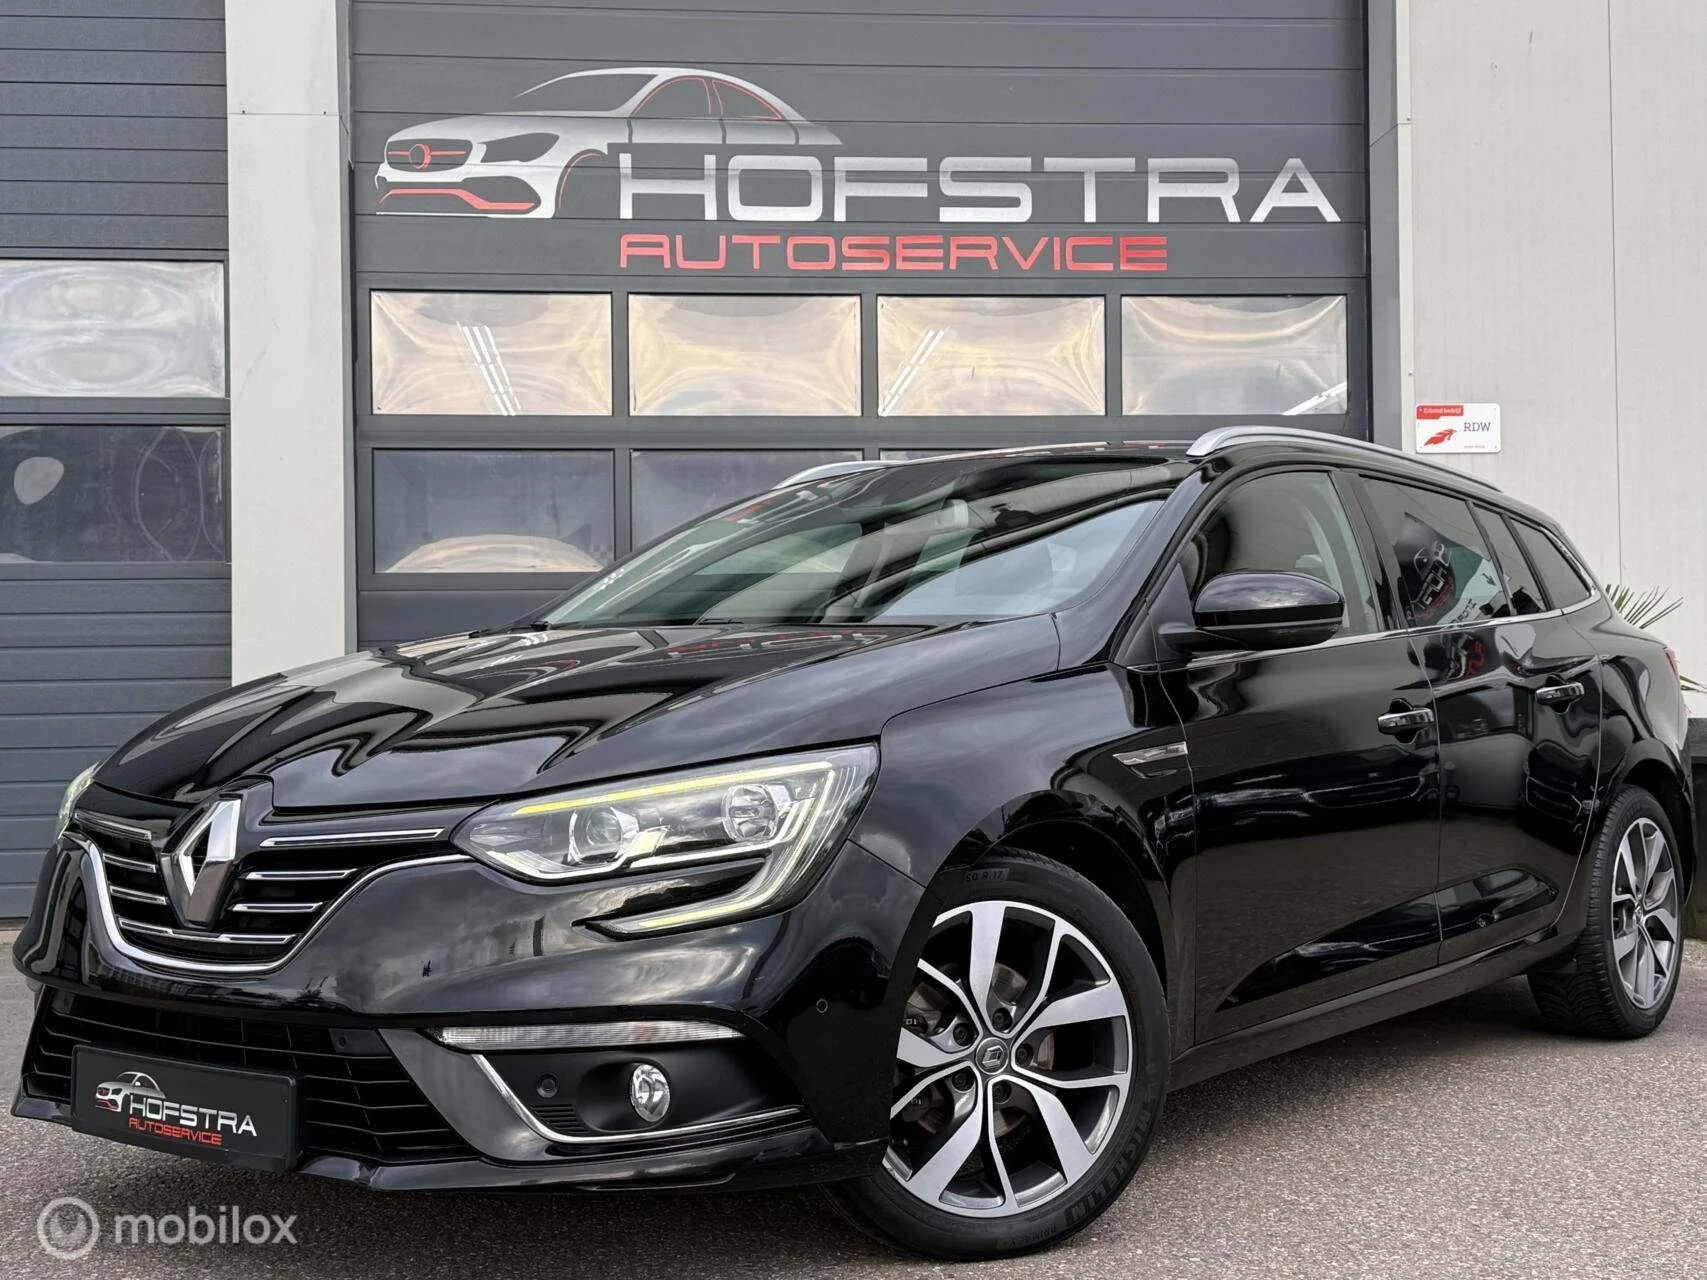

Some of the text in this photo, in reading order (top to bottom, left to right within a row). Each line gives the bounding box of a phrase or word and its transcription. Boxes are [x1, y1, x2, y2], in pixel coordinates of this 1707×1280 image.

[619, 152, 1341, 222] HOFSTRA
[620, 234, 1168, 272] AUTOSERVICE
[1463, 422, 1491, 432] RDW
[128, 1117, 223, 1146] AUTOSERVICE
[129, 1094, 257, 1137] HOFSTRA
[1070, 1107, 1153, 1221] MICHELIN
